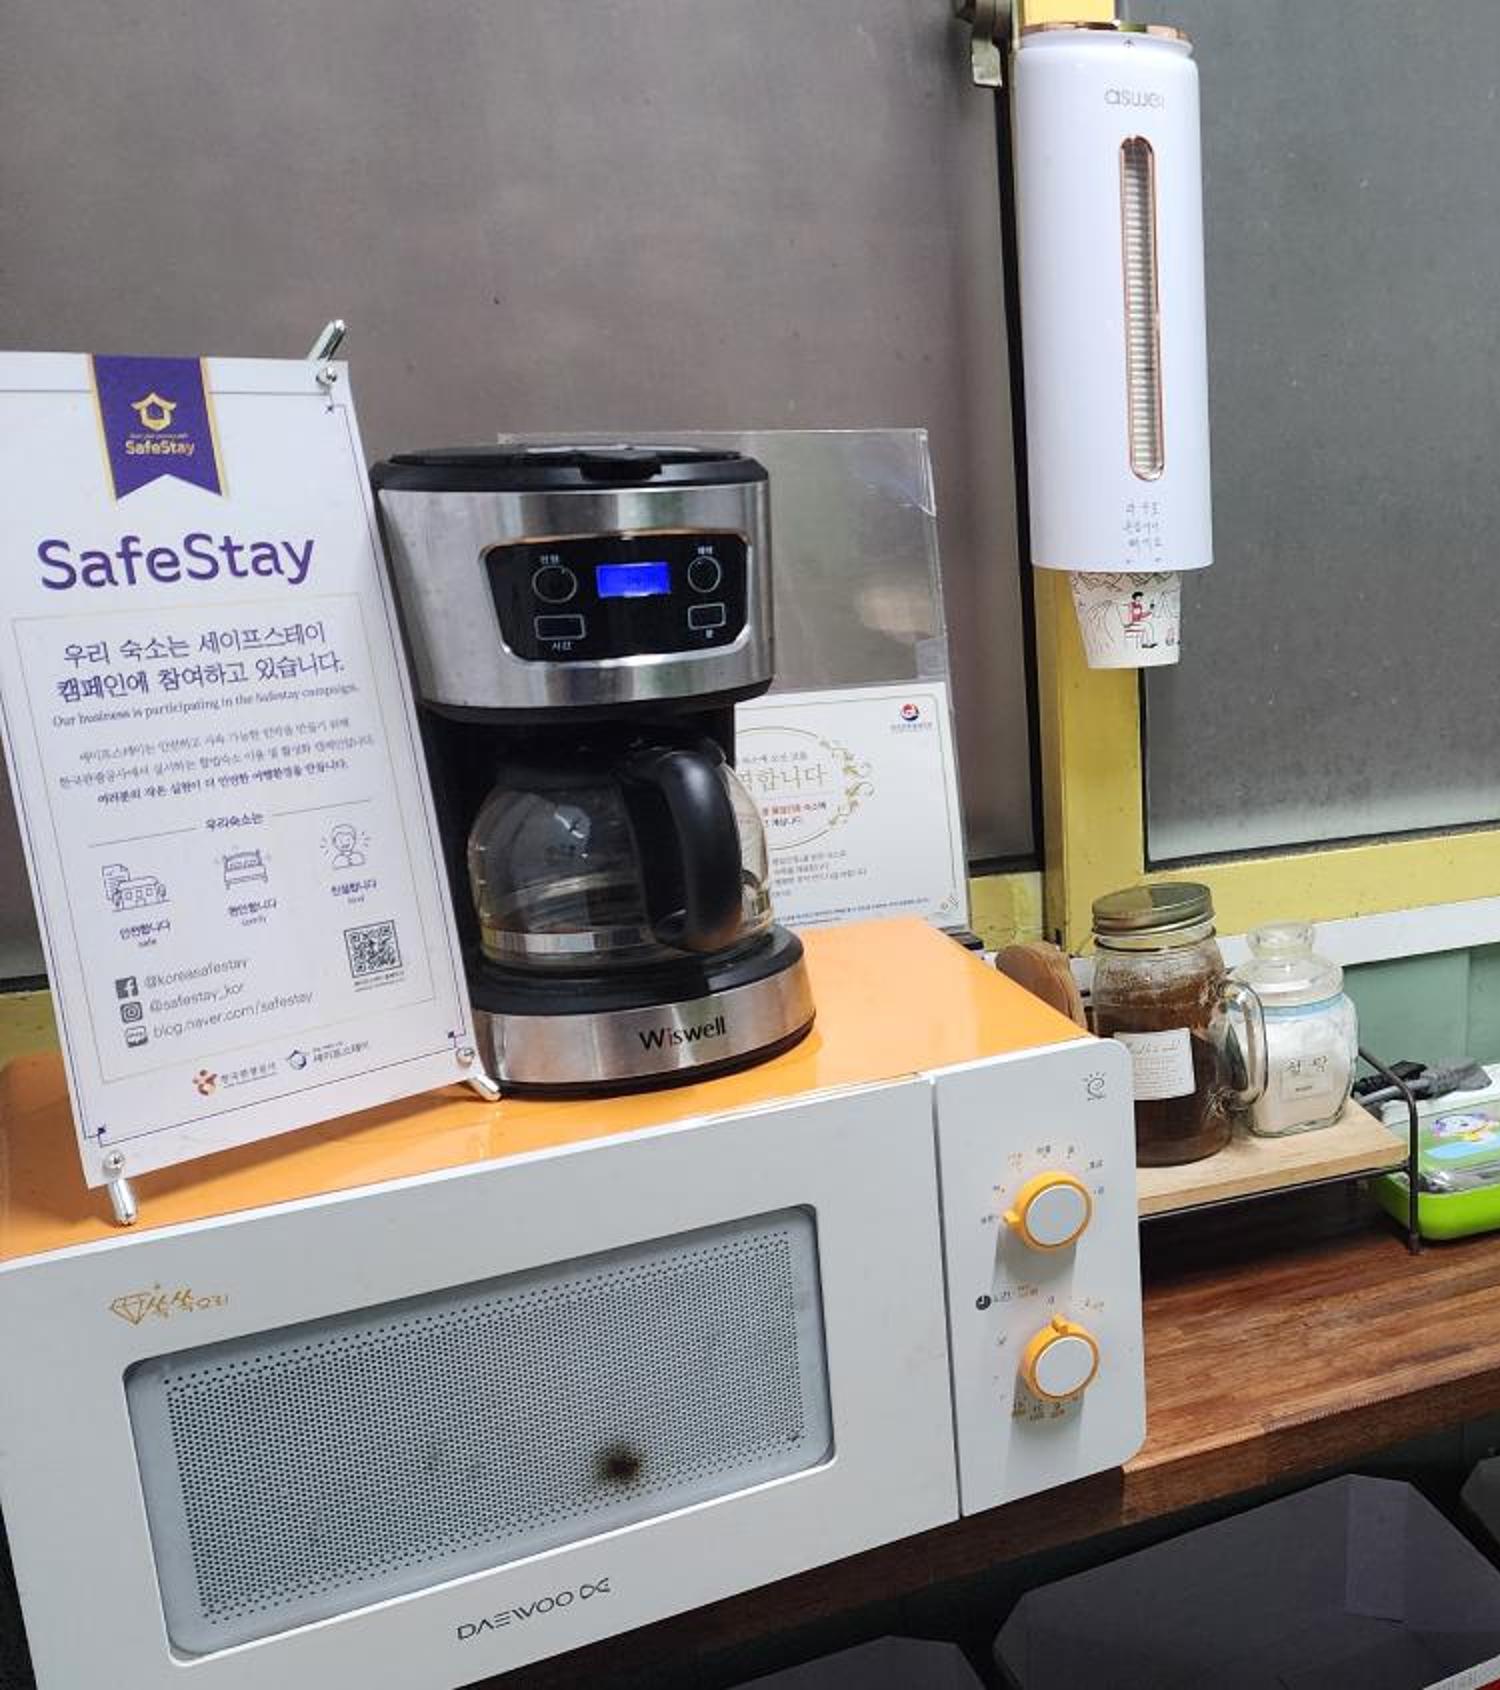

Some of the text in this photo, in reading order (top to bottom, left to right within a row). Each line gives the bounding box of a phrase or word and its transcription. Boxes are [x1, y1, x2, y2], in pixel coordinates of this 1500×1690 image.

[125, 439, 195, 457] SafeStay
[37, 532, 316, 591] SafeStay
[64, 621, 326, 668] 우리 숙소는 세이프스테이
[57, 651, 345, 703] 캠페인에 참여하고 있습니다.
[145, 697, 220, 719] participating
[222, 695, 233, 709] in
[235, 692, 252, 706] the
[143, 958, 250, 989] @koreasafestay
[150, 983, 244, 1012] @safestay_kor
[153, 990, 314, 1038] blog.naver.com/safestay
[639, 1016, 727, 1051] Wiswell
[457, 1591, 574, 1640] DAEWOO
